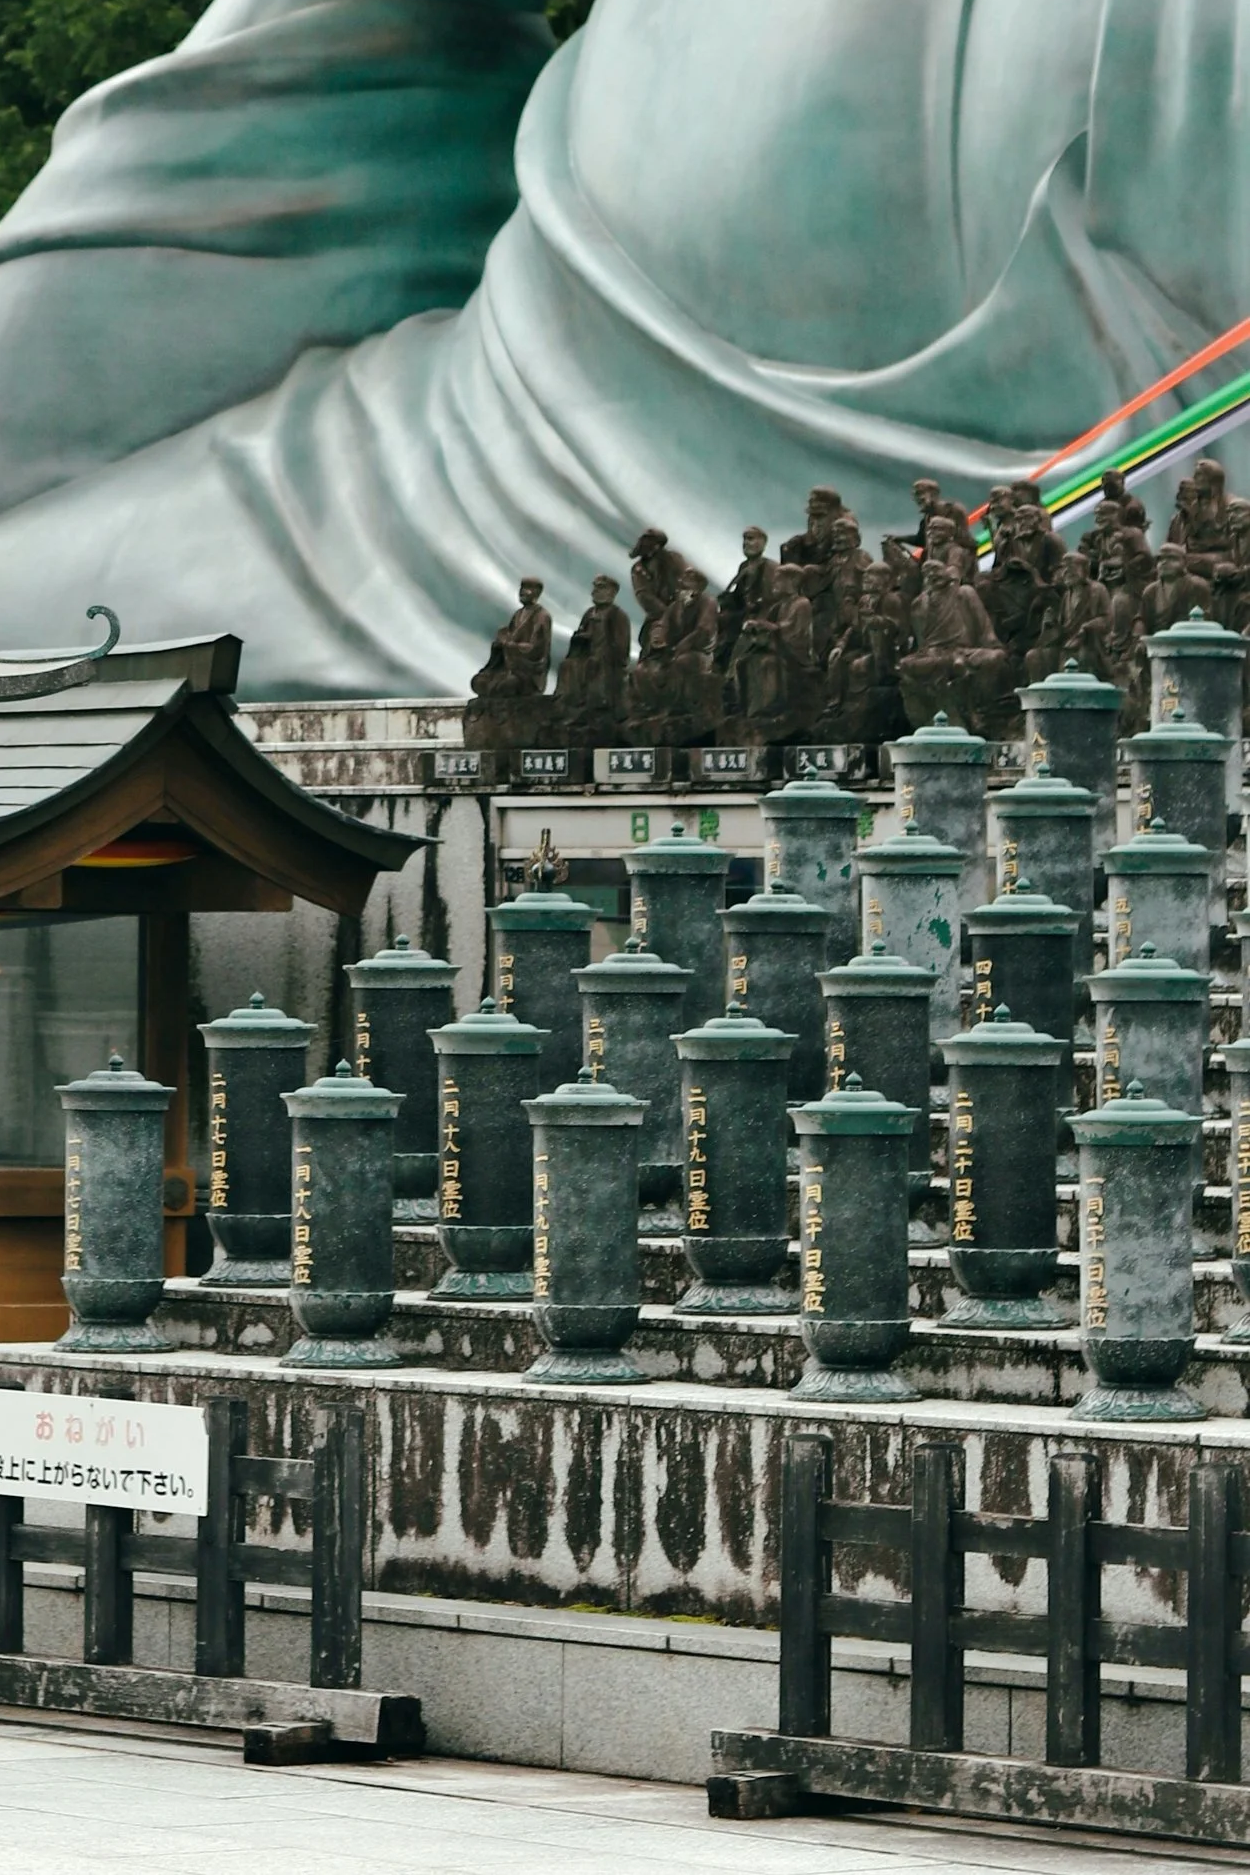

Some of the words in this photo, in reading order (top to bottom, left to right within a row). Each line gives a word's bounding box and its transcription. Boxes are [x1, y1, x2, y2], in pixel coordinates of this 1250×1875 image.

[356, 1013, 371, 1080] 三月十
[36, 1410, 145, 1448] おねがい
